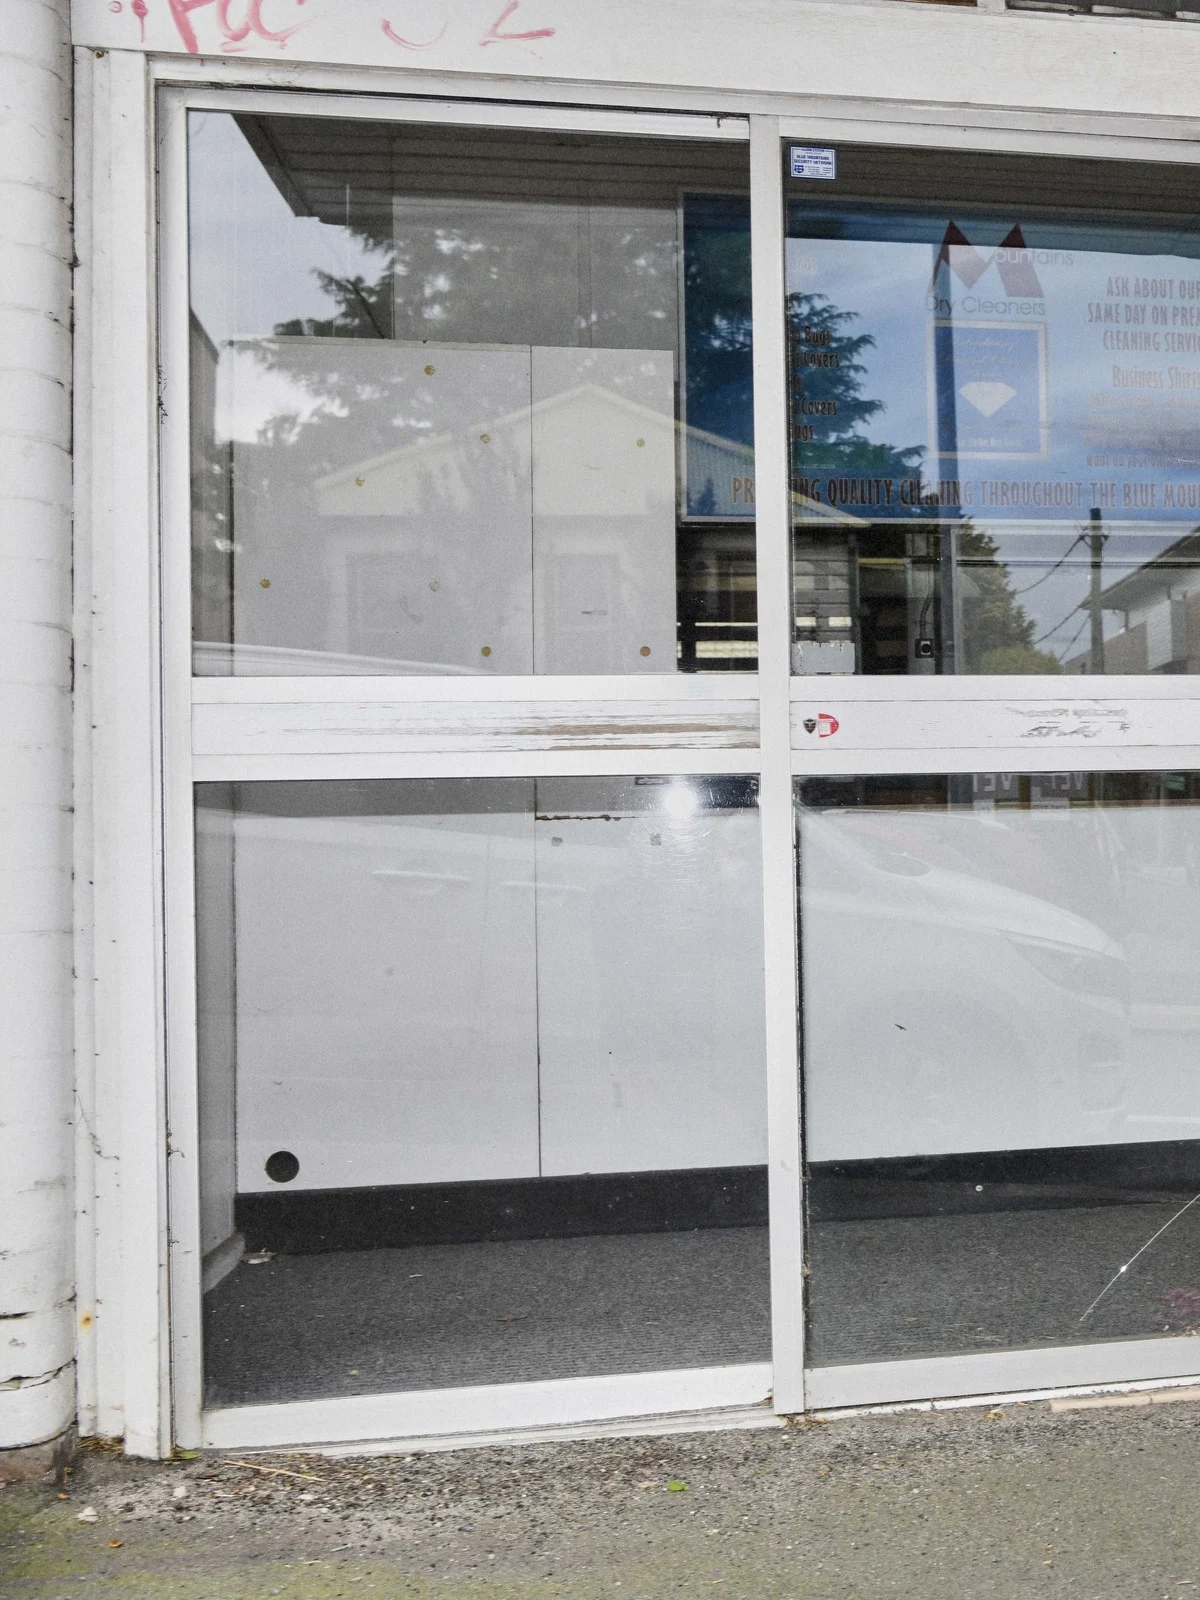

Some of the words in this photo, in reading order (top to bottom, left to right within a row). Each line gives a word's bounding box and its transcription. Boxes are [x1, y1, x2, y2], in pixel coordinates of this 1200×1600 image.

[1106, 276, 1130, 297] ASK
[1134, 277, 1175, 299] ABOUT
[924, 296, 955, 316] Dry
[961, 296, 1046, 316] Cleaners
[1087, 302, 1120, 324] SAME
[1124, 304, 1147, 325] DAY
[1151, 305, 1168, 326] ON
[1102, 330, 1161, 351] CLEANING
[803, 351, 840, 369] Covers
[1112, 365, 1165, 389] Business
[801, 396, 838, 417] Covers
[827, 477, 893, 506] QUALITY
[900, 478, 973, 507] CLEANING
[980, 480, 1083, 509] THROUGHOUT
[1090, 482, 1116, 508] THE
[1122, 482, 1156, 508] BLUE
